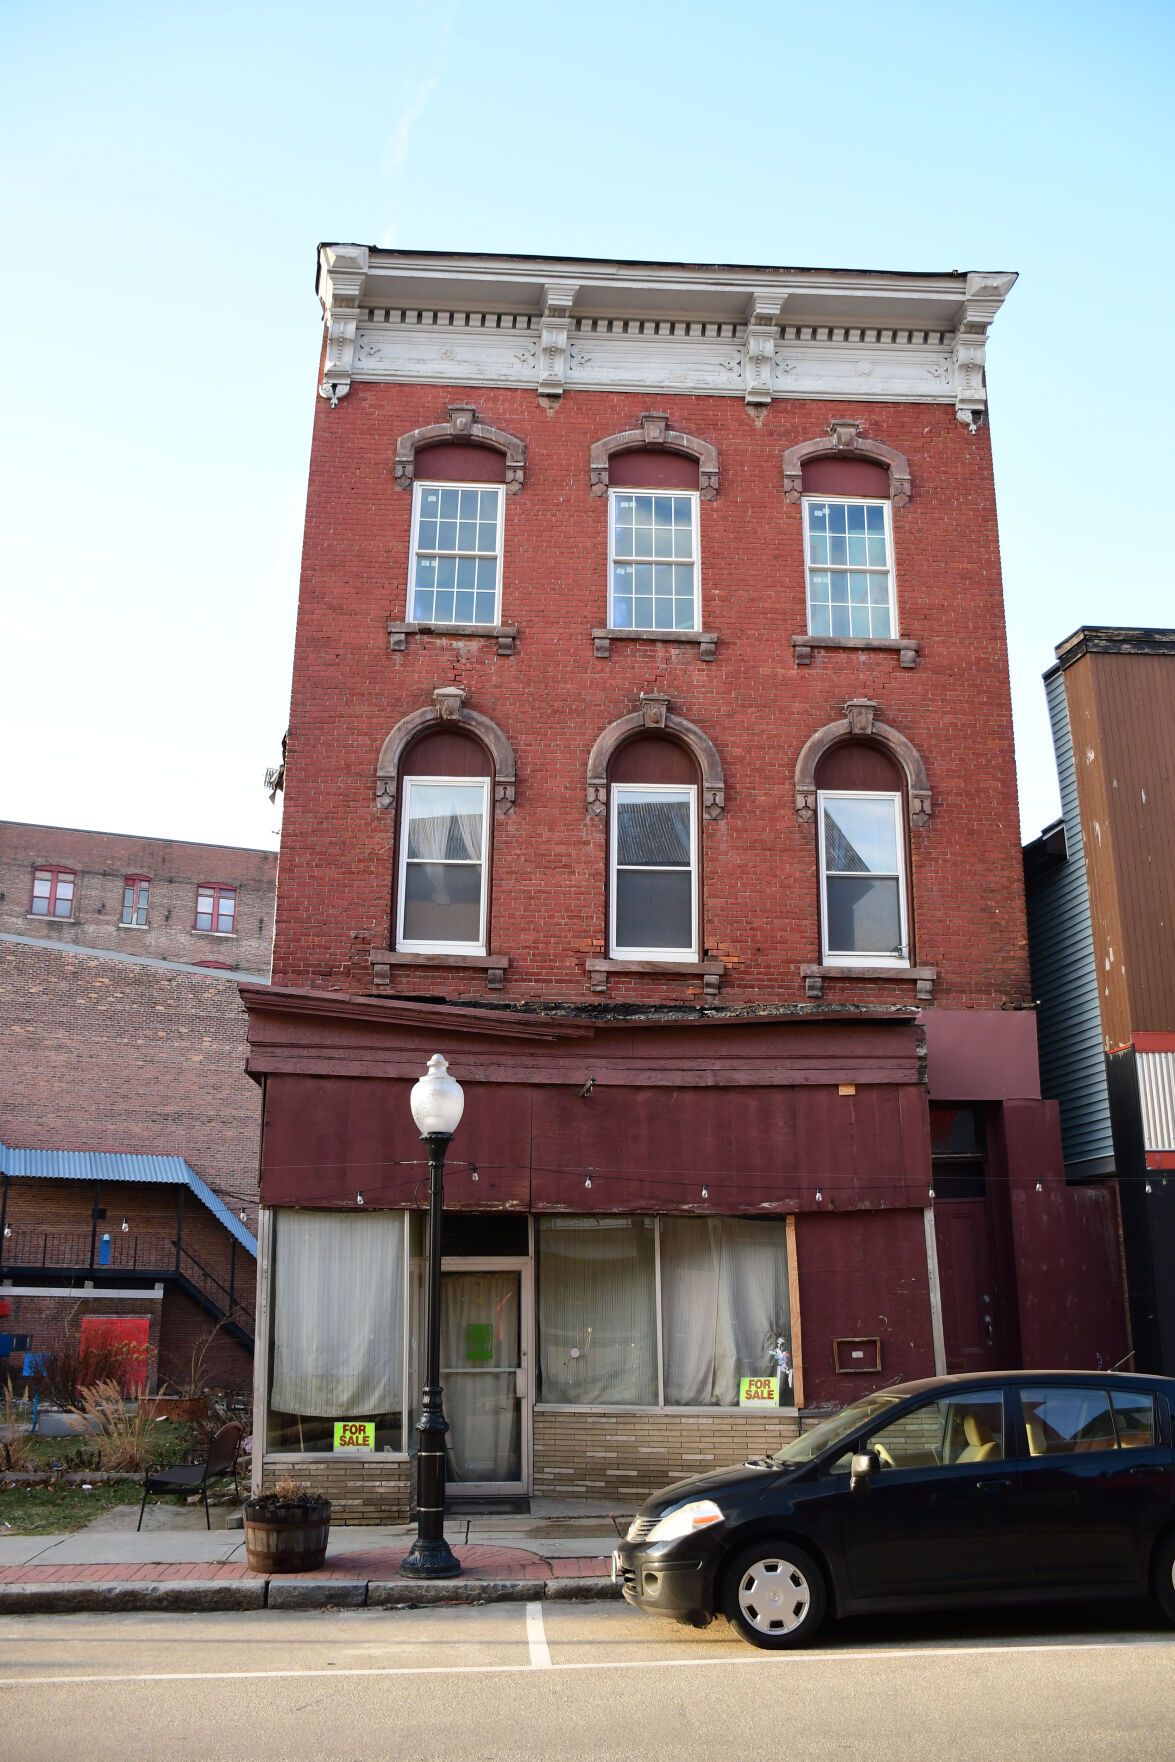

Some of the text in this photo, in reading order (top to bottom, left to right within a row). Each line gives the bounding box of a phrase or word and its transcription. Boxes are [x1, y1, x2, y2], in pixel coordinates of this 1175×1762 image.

[748, 1379, 771, 1389] FOR
[745, 1390, 774, 1400] SALE
[342, 1424, 367, 1435] FOR
[339, 1435, 370, 1447] SALE
